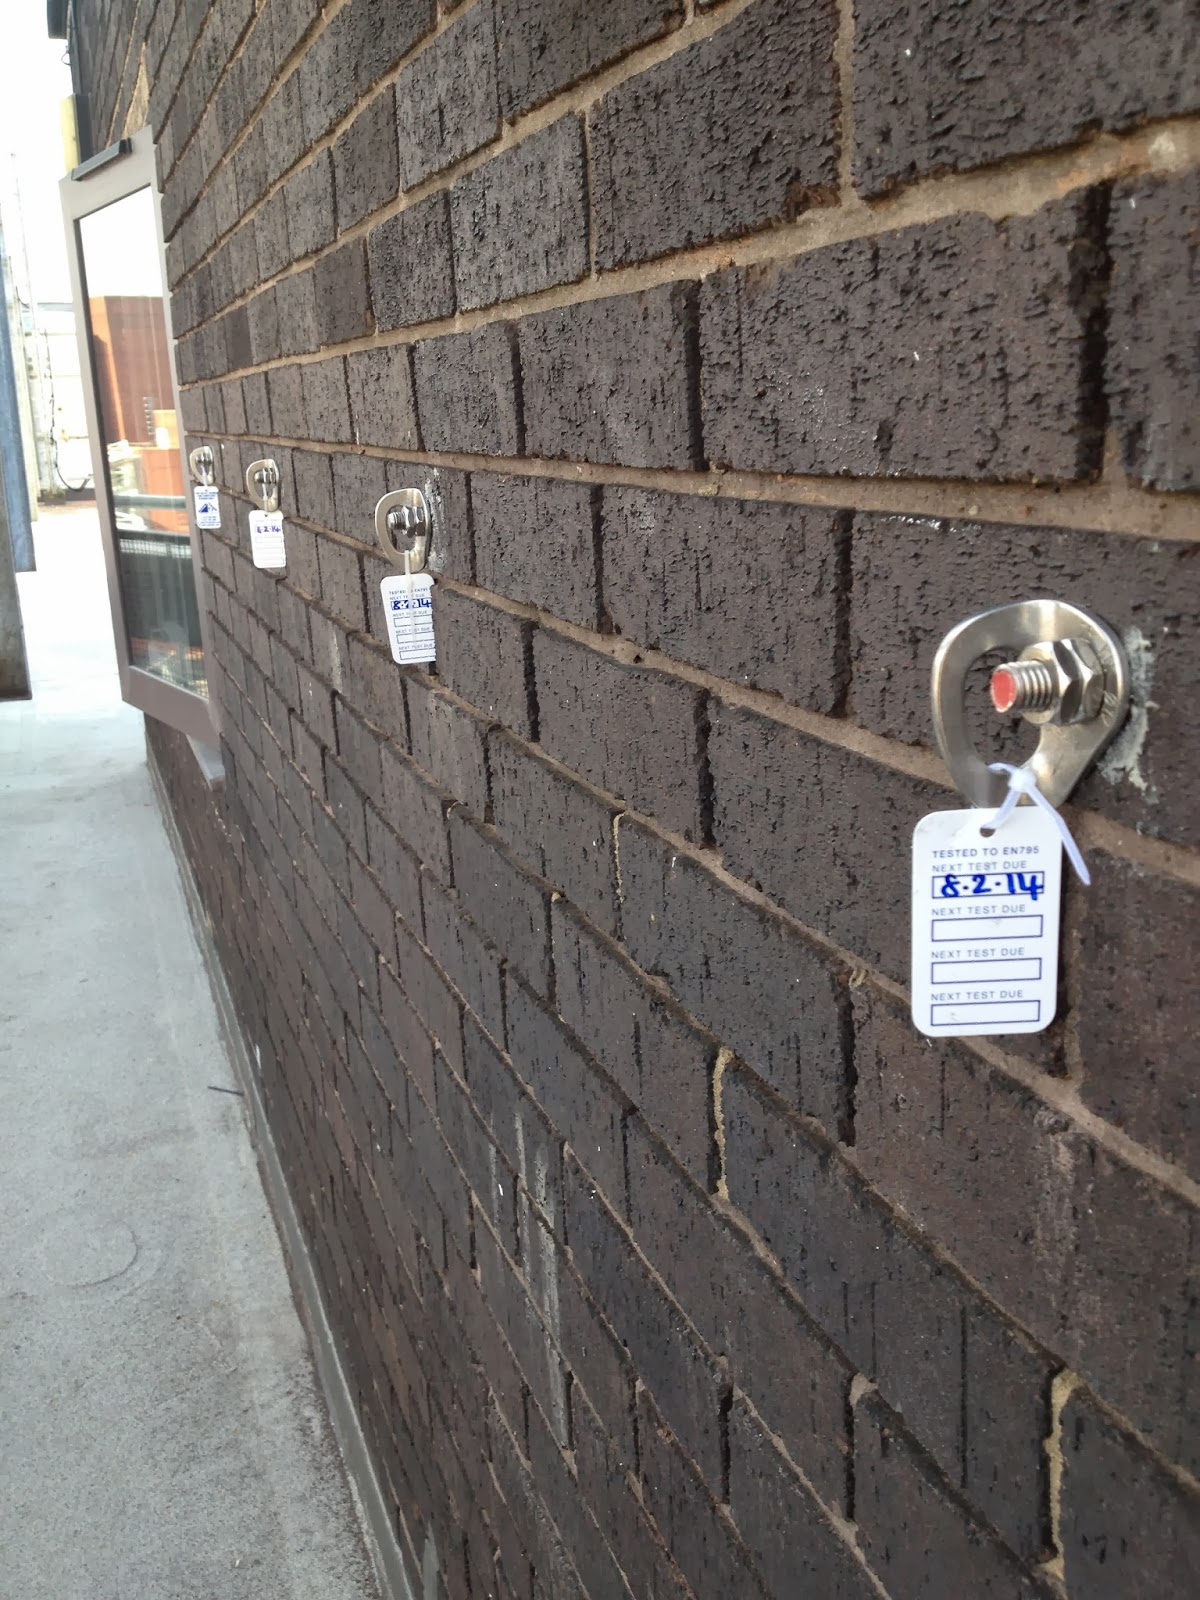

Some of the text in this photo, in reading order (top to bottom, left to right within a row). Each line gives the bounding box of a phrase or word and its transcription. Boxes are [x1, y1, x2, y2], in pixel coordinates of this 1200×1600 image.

[932, 846, 1040, 858] TESTED TO EN795
[932, 860, 1027, 872] NEXT TEST DUE
[932, 904, 1026, 916] NEXT TEST DUE
[931, 947, 1024, 959] NEXT TEST DUE
[931, 990, 1024, 1001] NEXT TEST DUE
